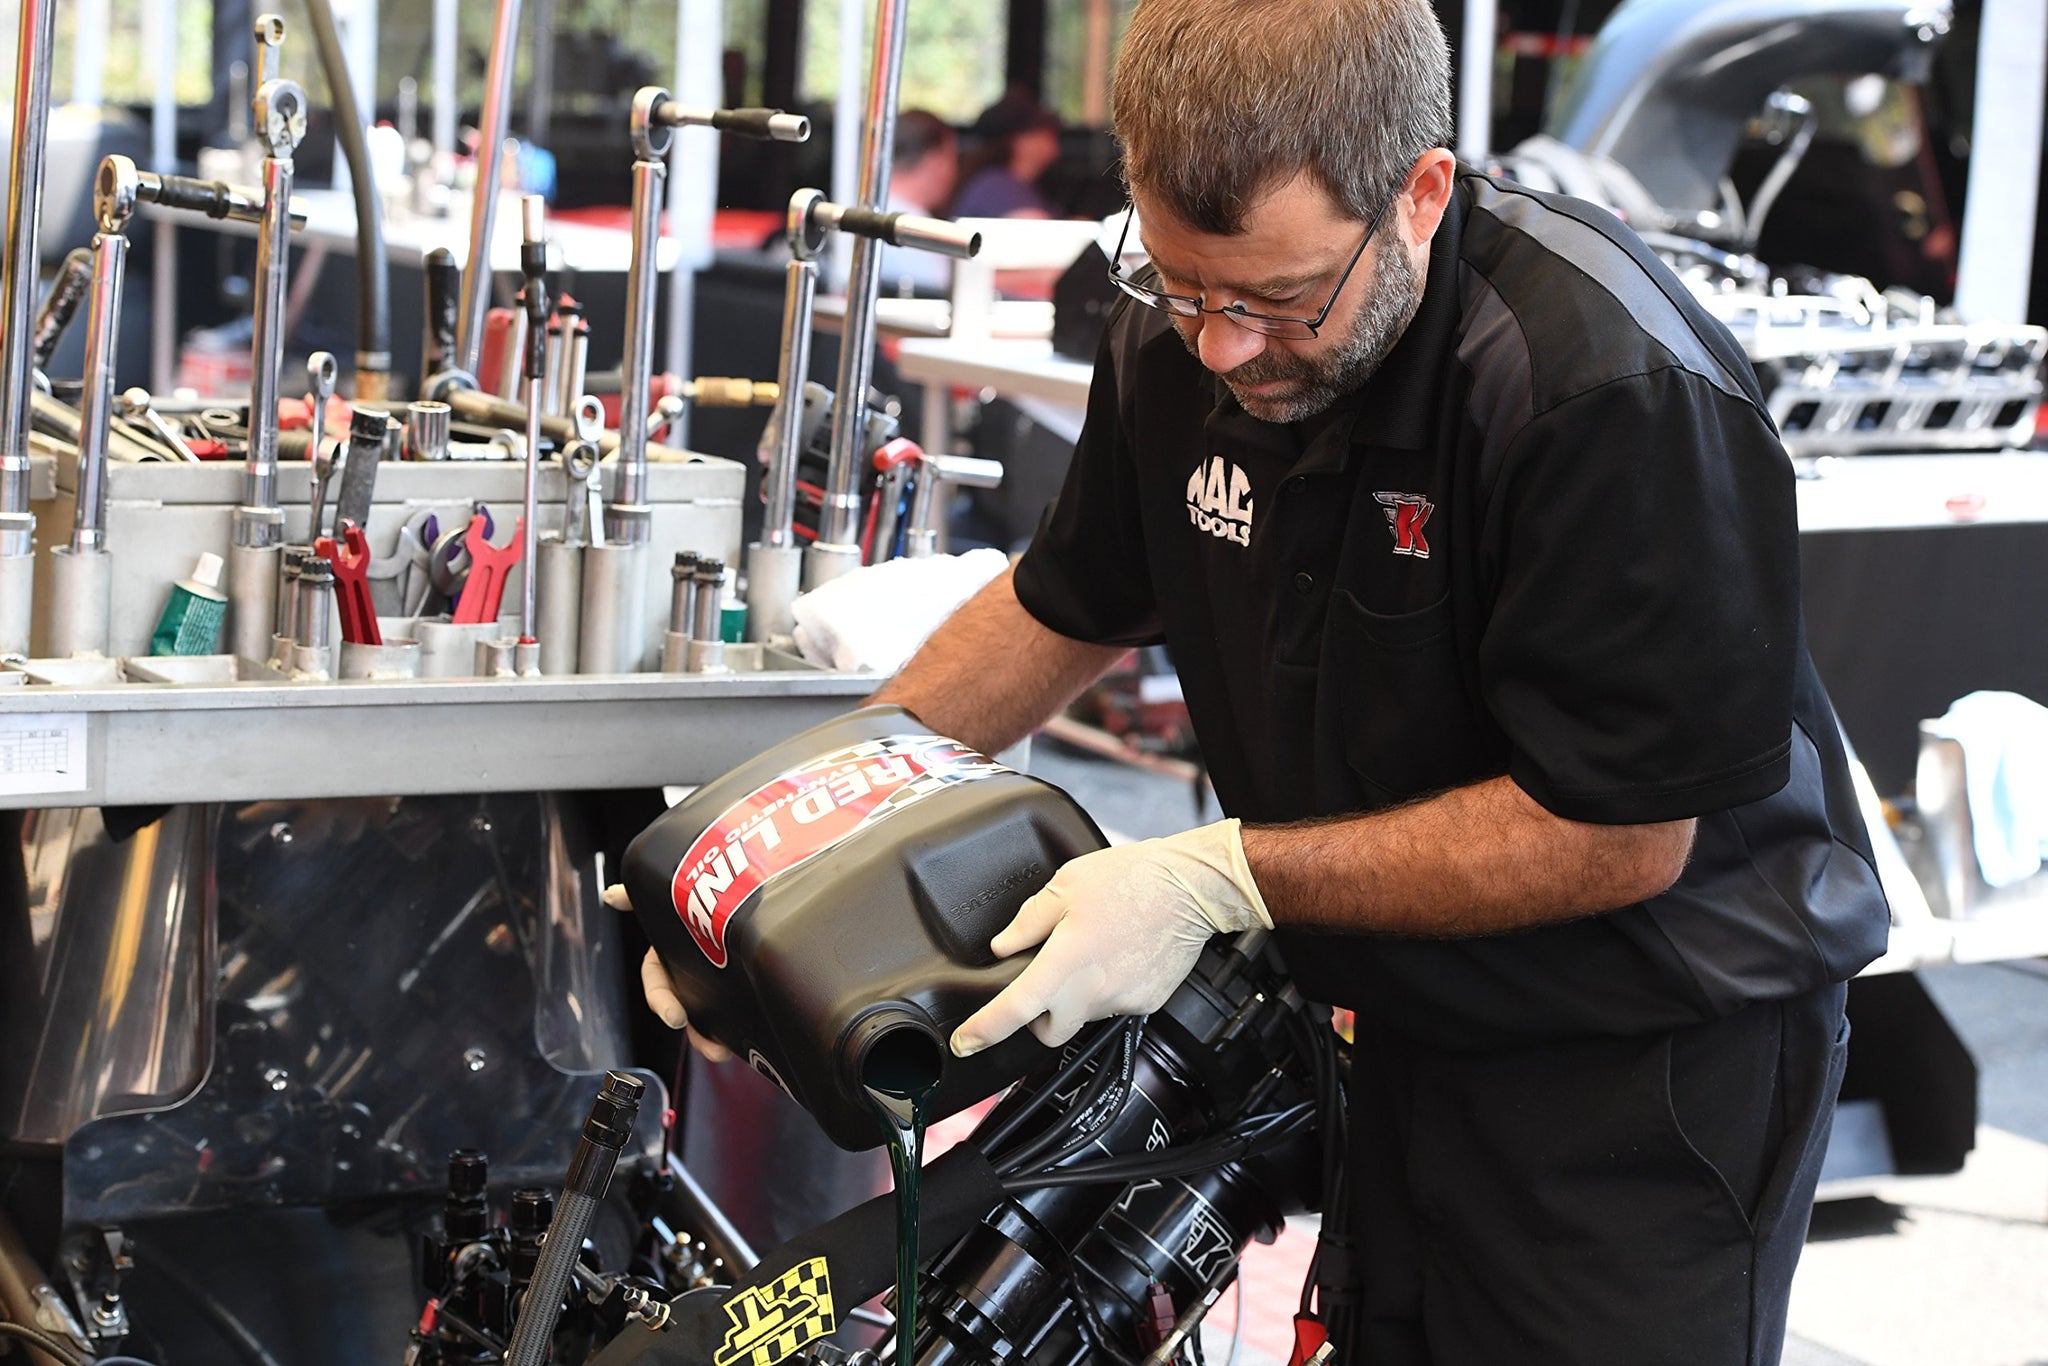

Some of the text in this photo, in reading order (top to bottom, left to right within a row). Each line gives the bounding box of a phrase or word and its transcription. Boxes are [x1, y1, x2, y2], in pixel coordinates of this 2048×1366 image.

[1186, 455, 1253, 526] MAC
[1186, 503, 1251, 547] TOOLS
[686, 763, 859, 882] SYNTHETIC OIL
[687, 754, 915, 951] RED LINE
[1021, 862, 1041, 880] DO
[950, 886, 1000, 921] REUSE
[1121, 1031, 1132, 1081] CONDUCTOR
[1109, 1087, 1124, 1112] SPARK
